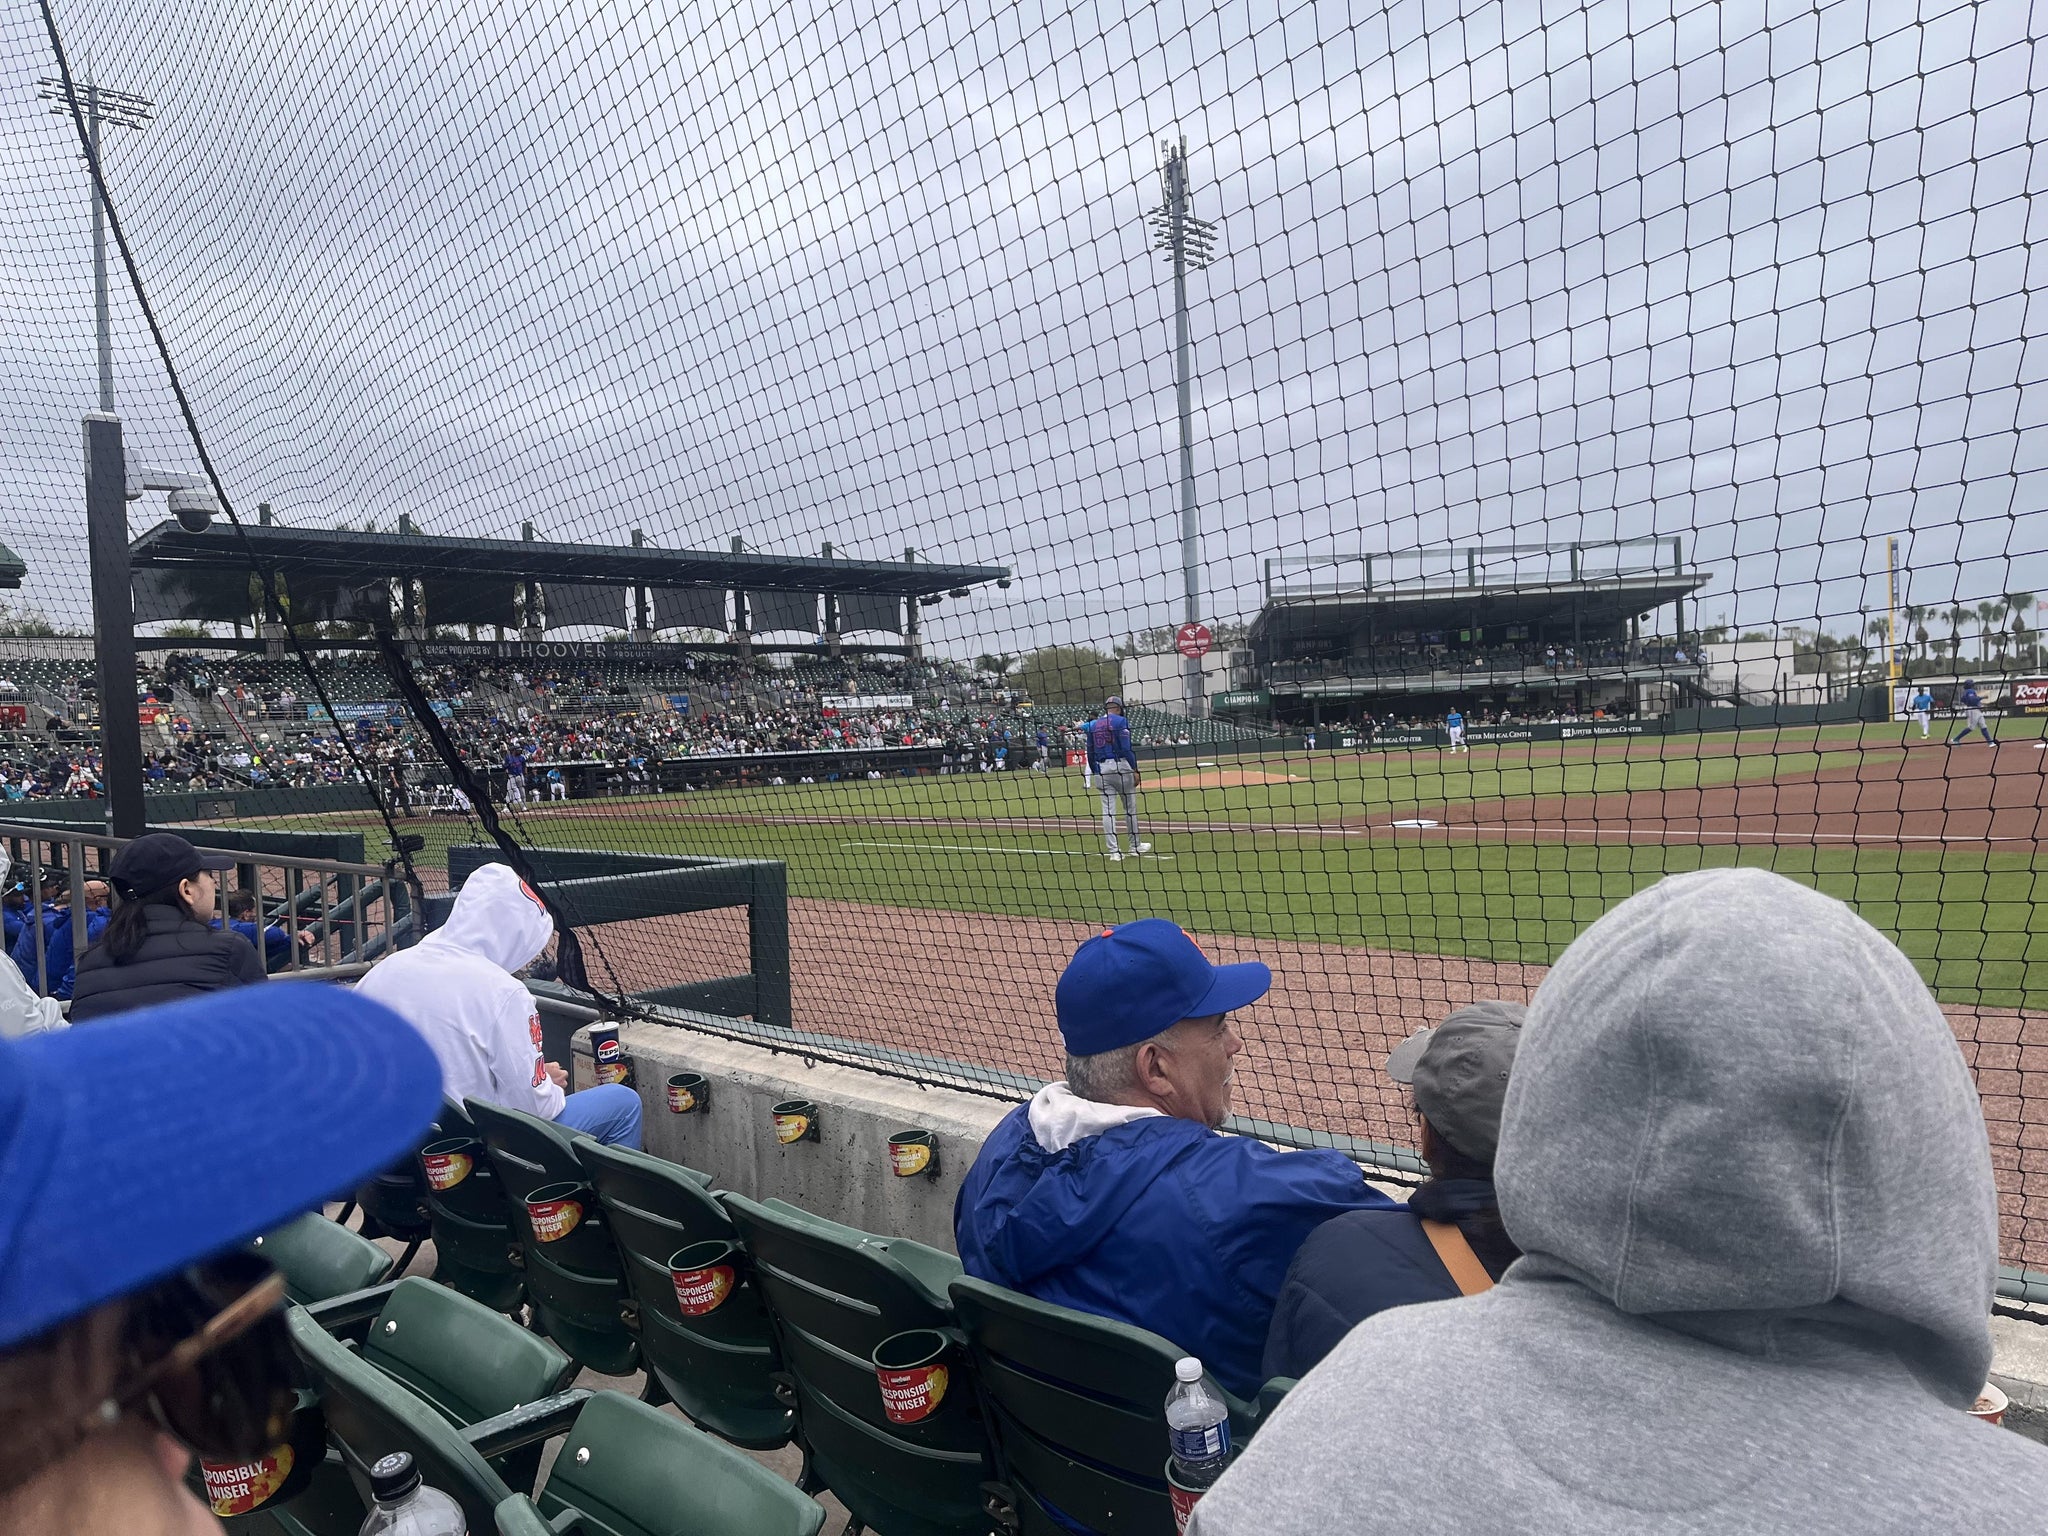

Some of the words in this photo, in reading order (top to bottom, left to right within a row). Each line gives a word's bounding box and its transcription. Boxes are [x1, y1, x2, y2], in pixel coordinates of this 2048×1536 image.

[520, 643, 606, 657] HOOVER
[1224, 694, 1260, 704] CHAMPIONS
[1571, 728, 1593, 737] JUPITER
[1398, 735, 1422, 743] CENTER
[433, 1172, 455, 1182] WISER
[540, 1221, 563, 1232] WISER
[688, 1291, 716, 1305] WISER
[895, 1395, 927, 1411] WISER
[211, 1482, 251, 1499] WISER
